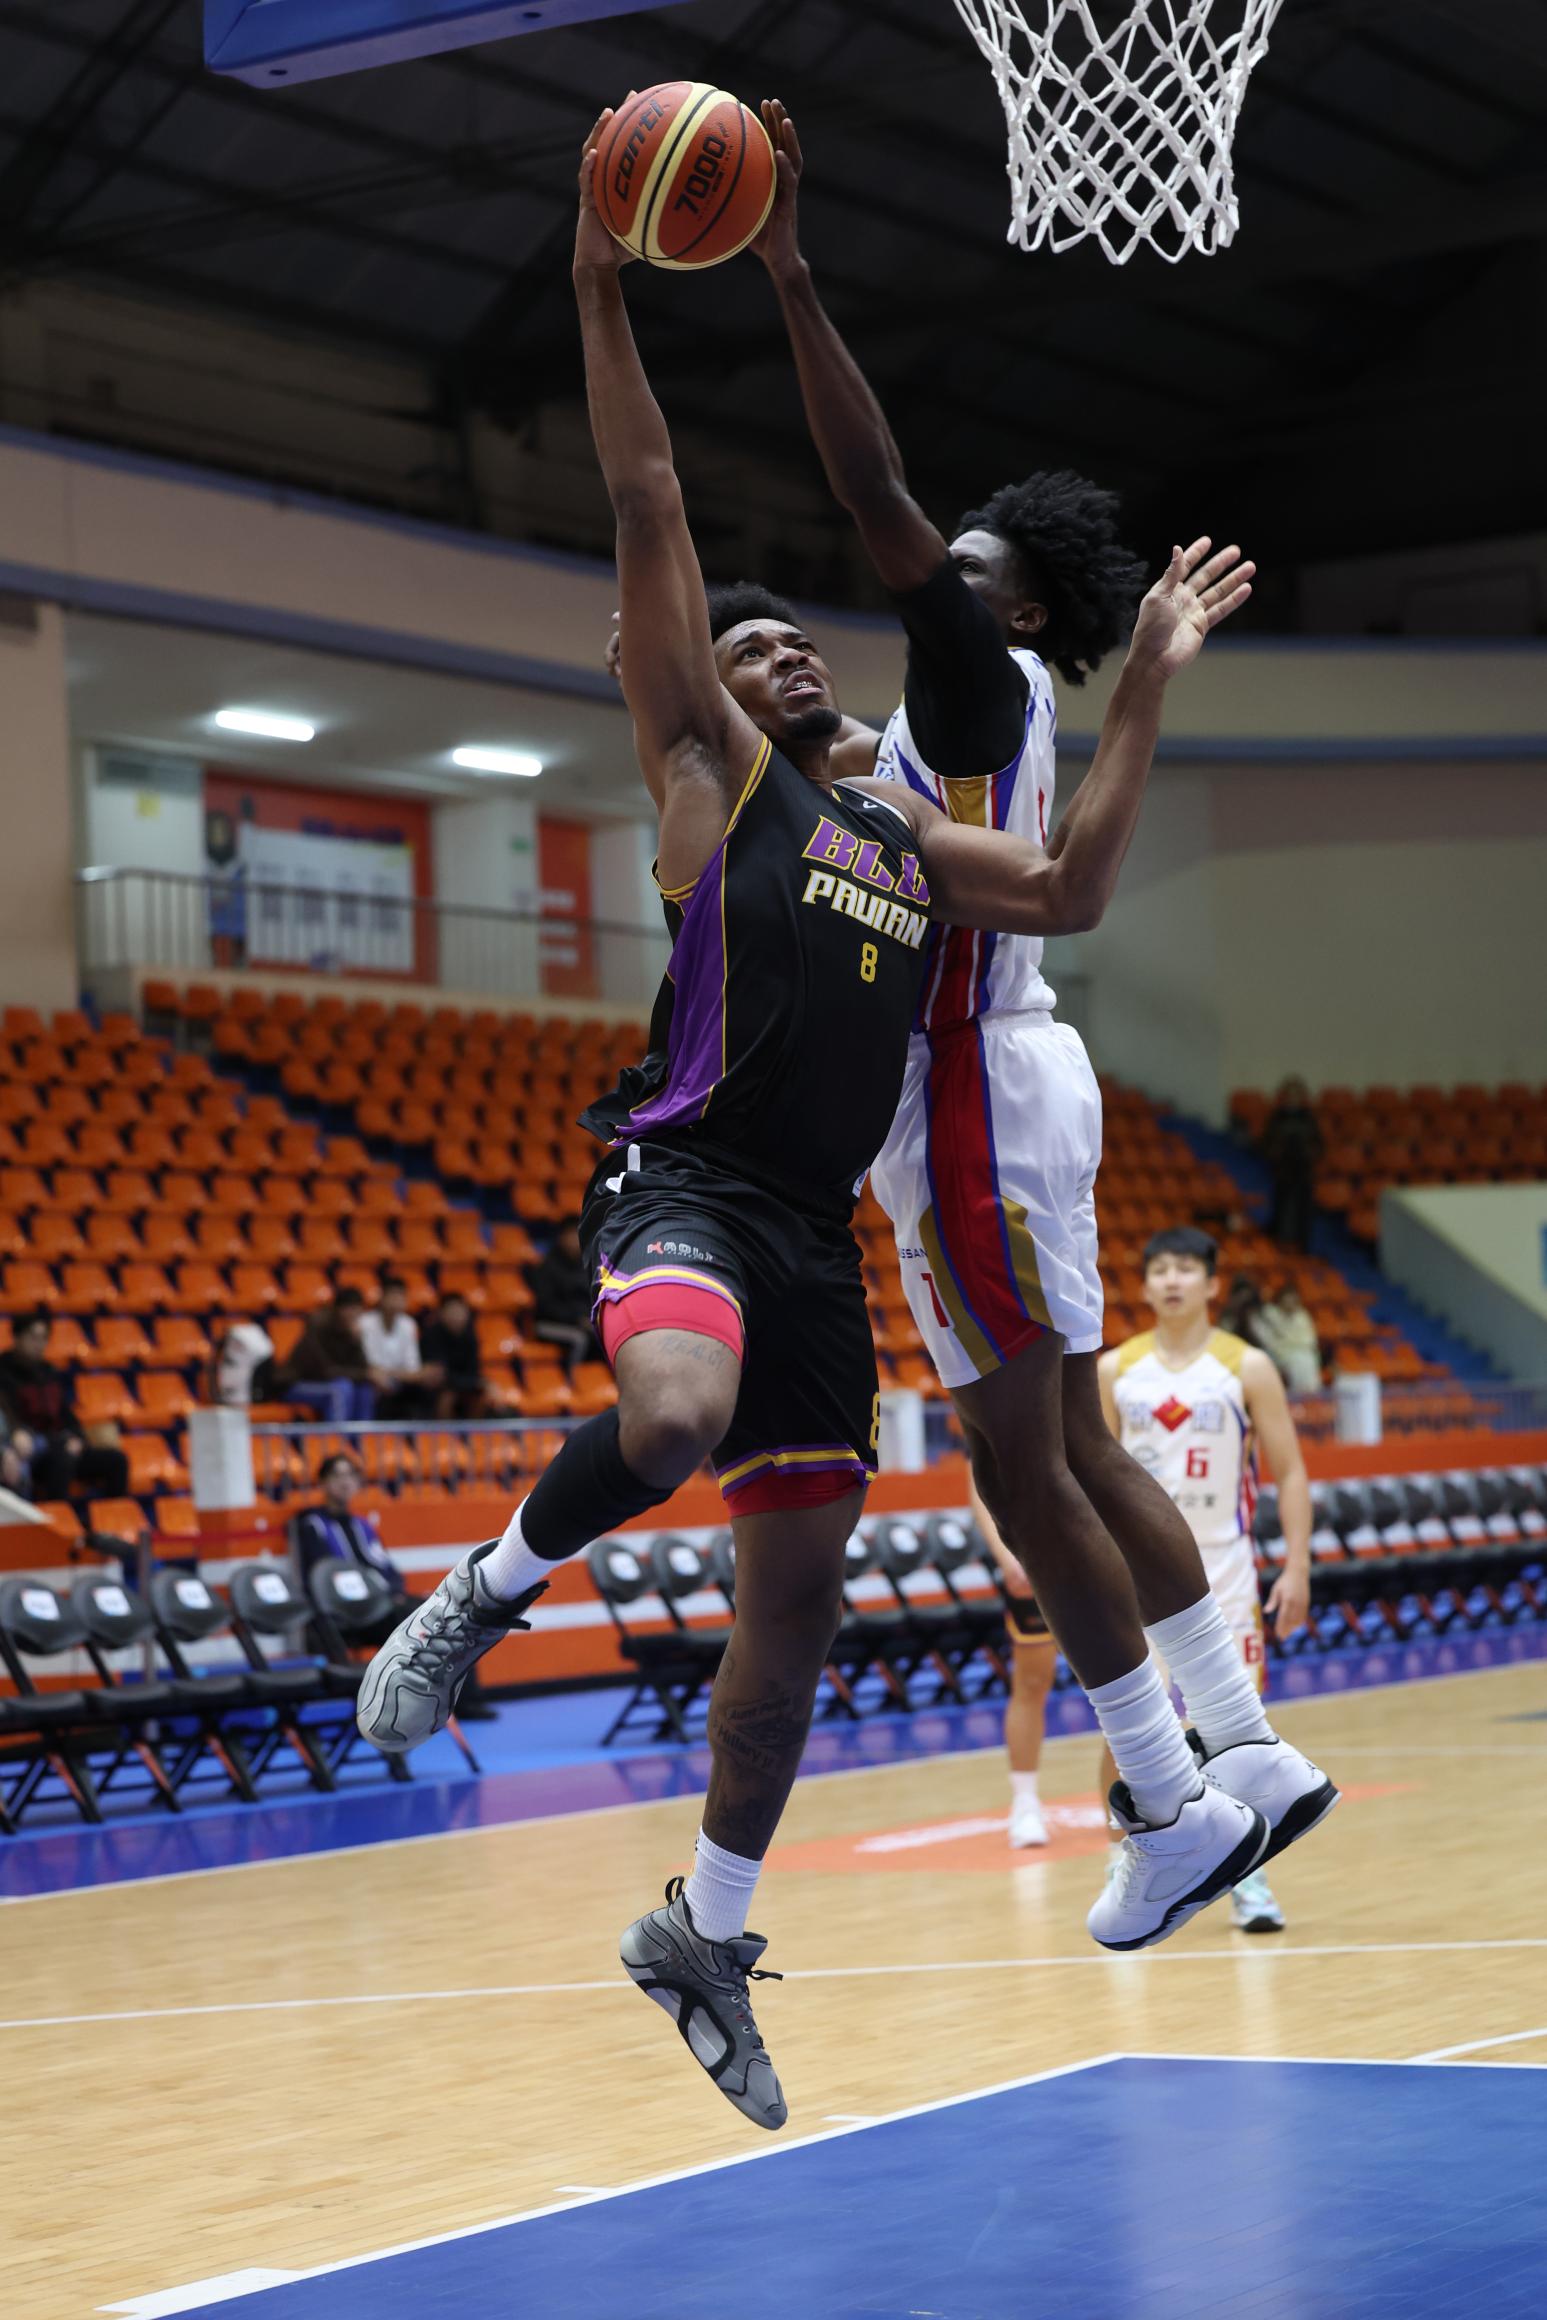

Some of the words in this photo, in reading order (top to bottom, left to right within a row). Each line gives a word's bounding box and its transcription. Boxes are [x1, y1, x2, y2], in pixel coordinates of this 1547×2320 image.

[674, 134, 726, 215] 7000
[801, 868, 929, 951] PAUIAN
[860, 941, 879, 984] 8
[919, 1272, 951, 1328] 1
[1186, 1446, 1210, 1479] 6
[1243, 1634, 1264, 1664] 6
